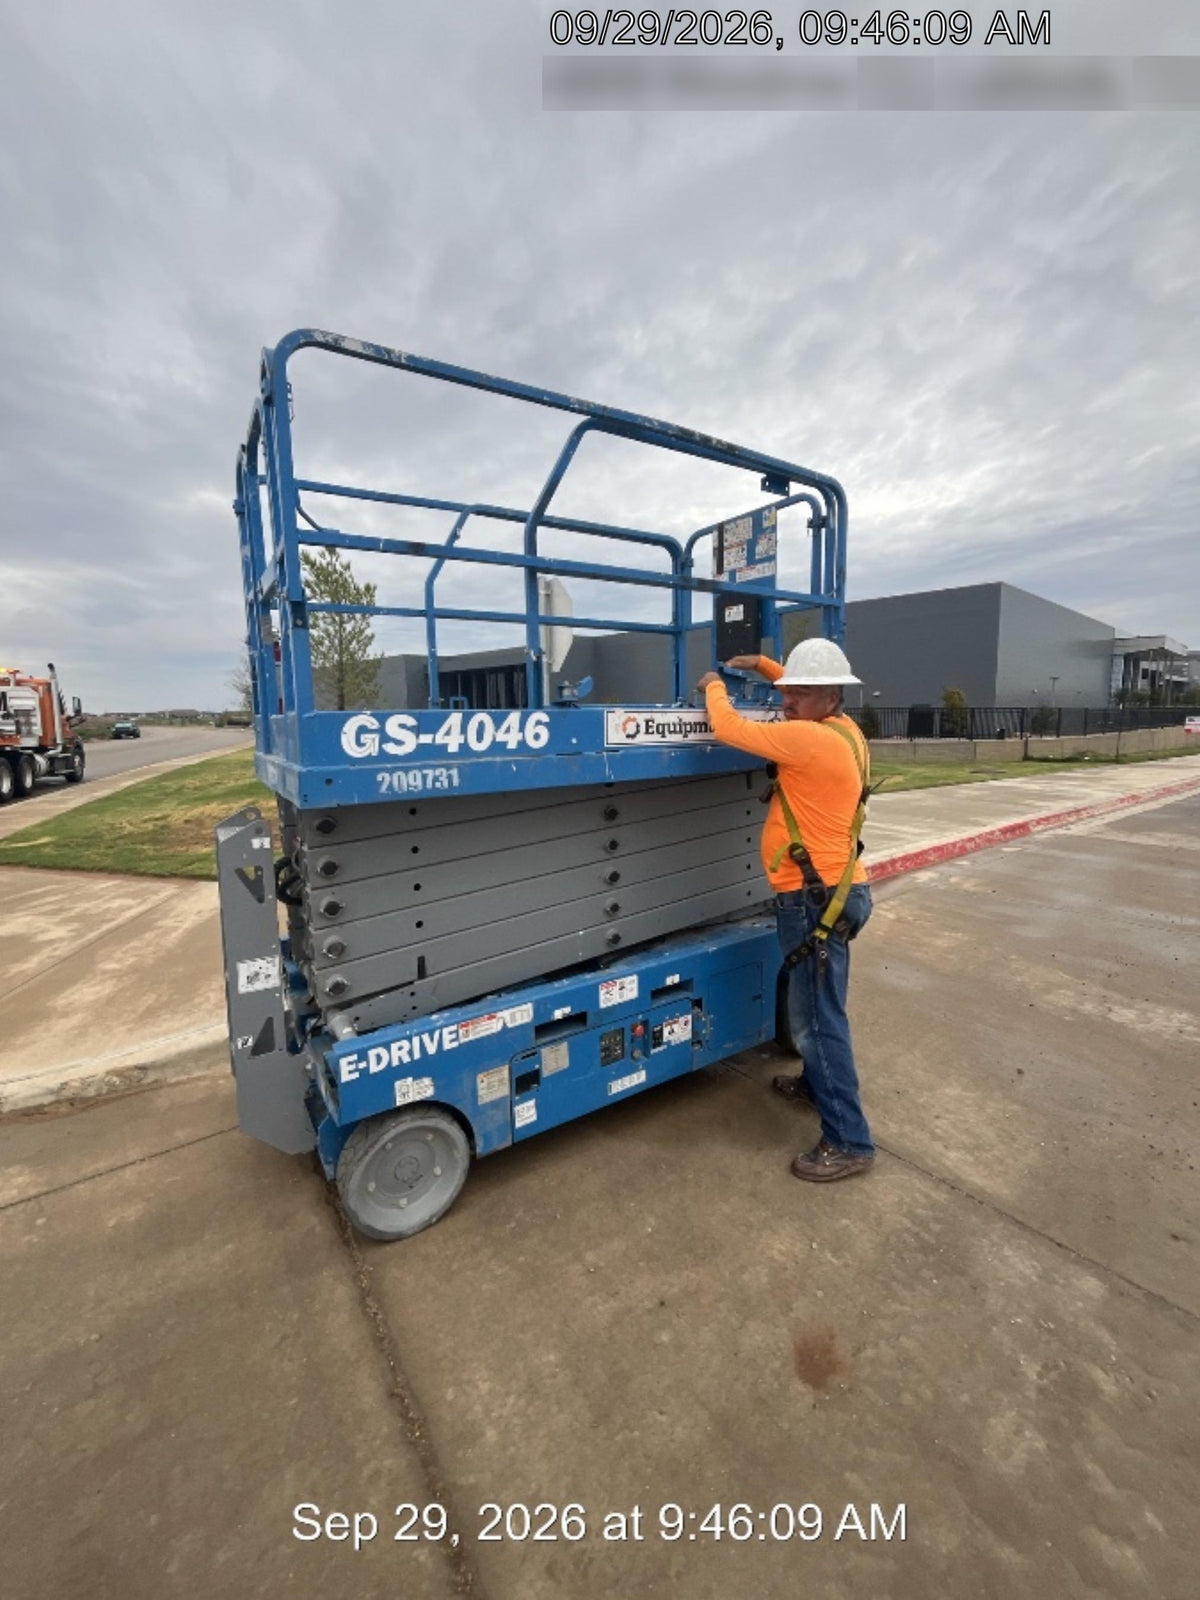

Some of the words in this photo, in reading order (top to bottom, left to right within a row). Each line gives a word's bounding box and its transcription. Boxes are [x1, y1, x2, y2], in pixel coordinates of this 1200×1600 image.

[341, 711, 550, 758] GS-4046
[376, 767, 461, 794] 209731
[339, 1024, 460, 1083] E-DRIVE
